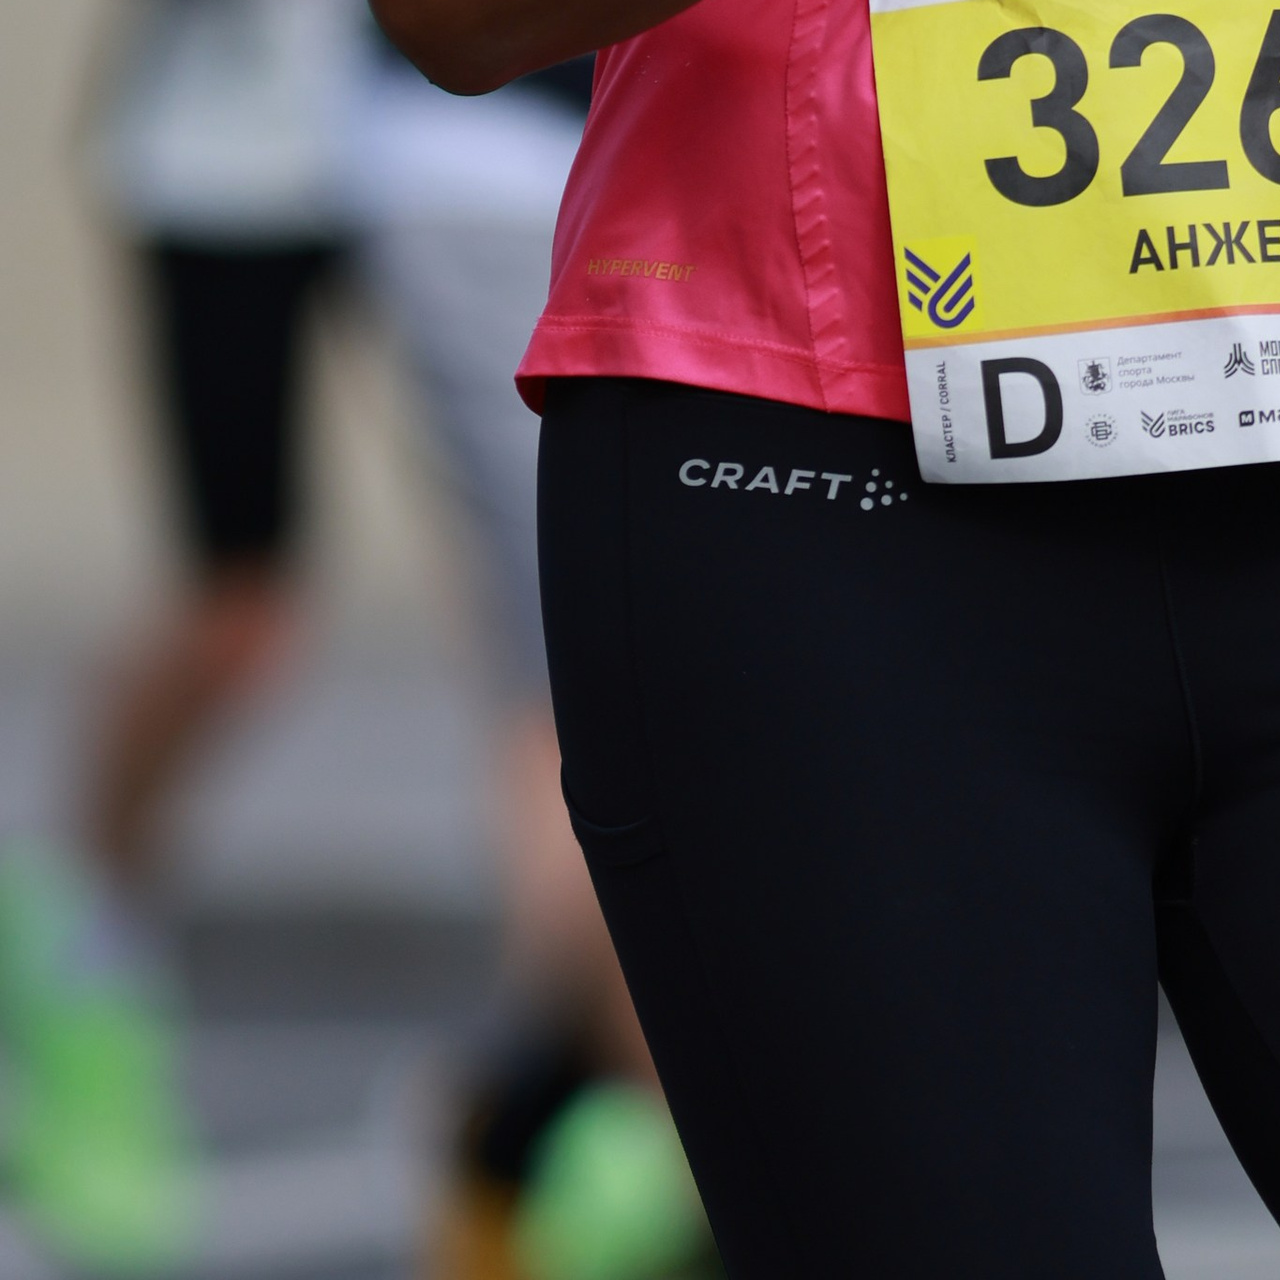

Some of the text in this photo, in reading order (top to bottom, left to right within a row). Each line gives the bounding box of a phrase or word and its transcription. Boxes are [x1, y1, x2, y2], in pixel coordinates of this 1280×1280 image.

[587, 258, 695, 282] HYPERVENT
[1117, 351, 1182, 366] Департамент
[936, 360, 950, 405] CORRAL
[1118, 367, 1152, 377] спорта
[1119, 375, 1195, 390] города Москвы
[981, 357, 1064, 460] D
[942, 414, 957, 463] КЛАСТЕР
[1168, 420, 1215, 437] BRICS
[678, 458, 853, 500] CRAFT
